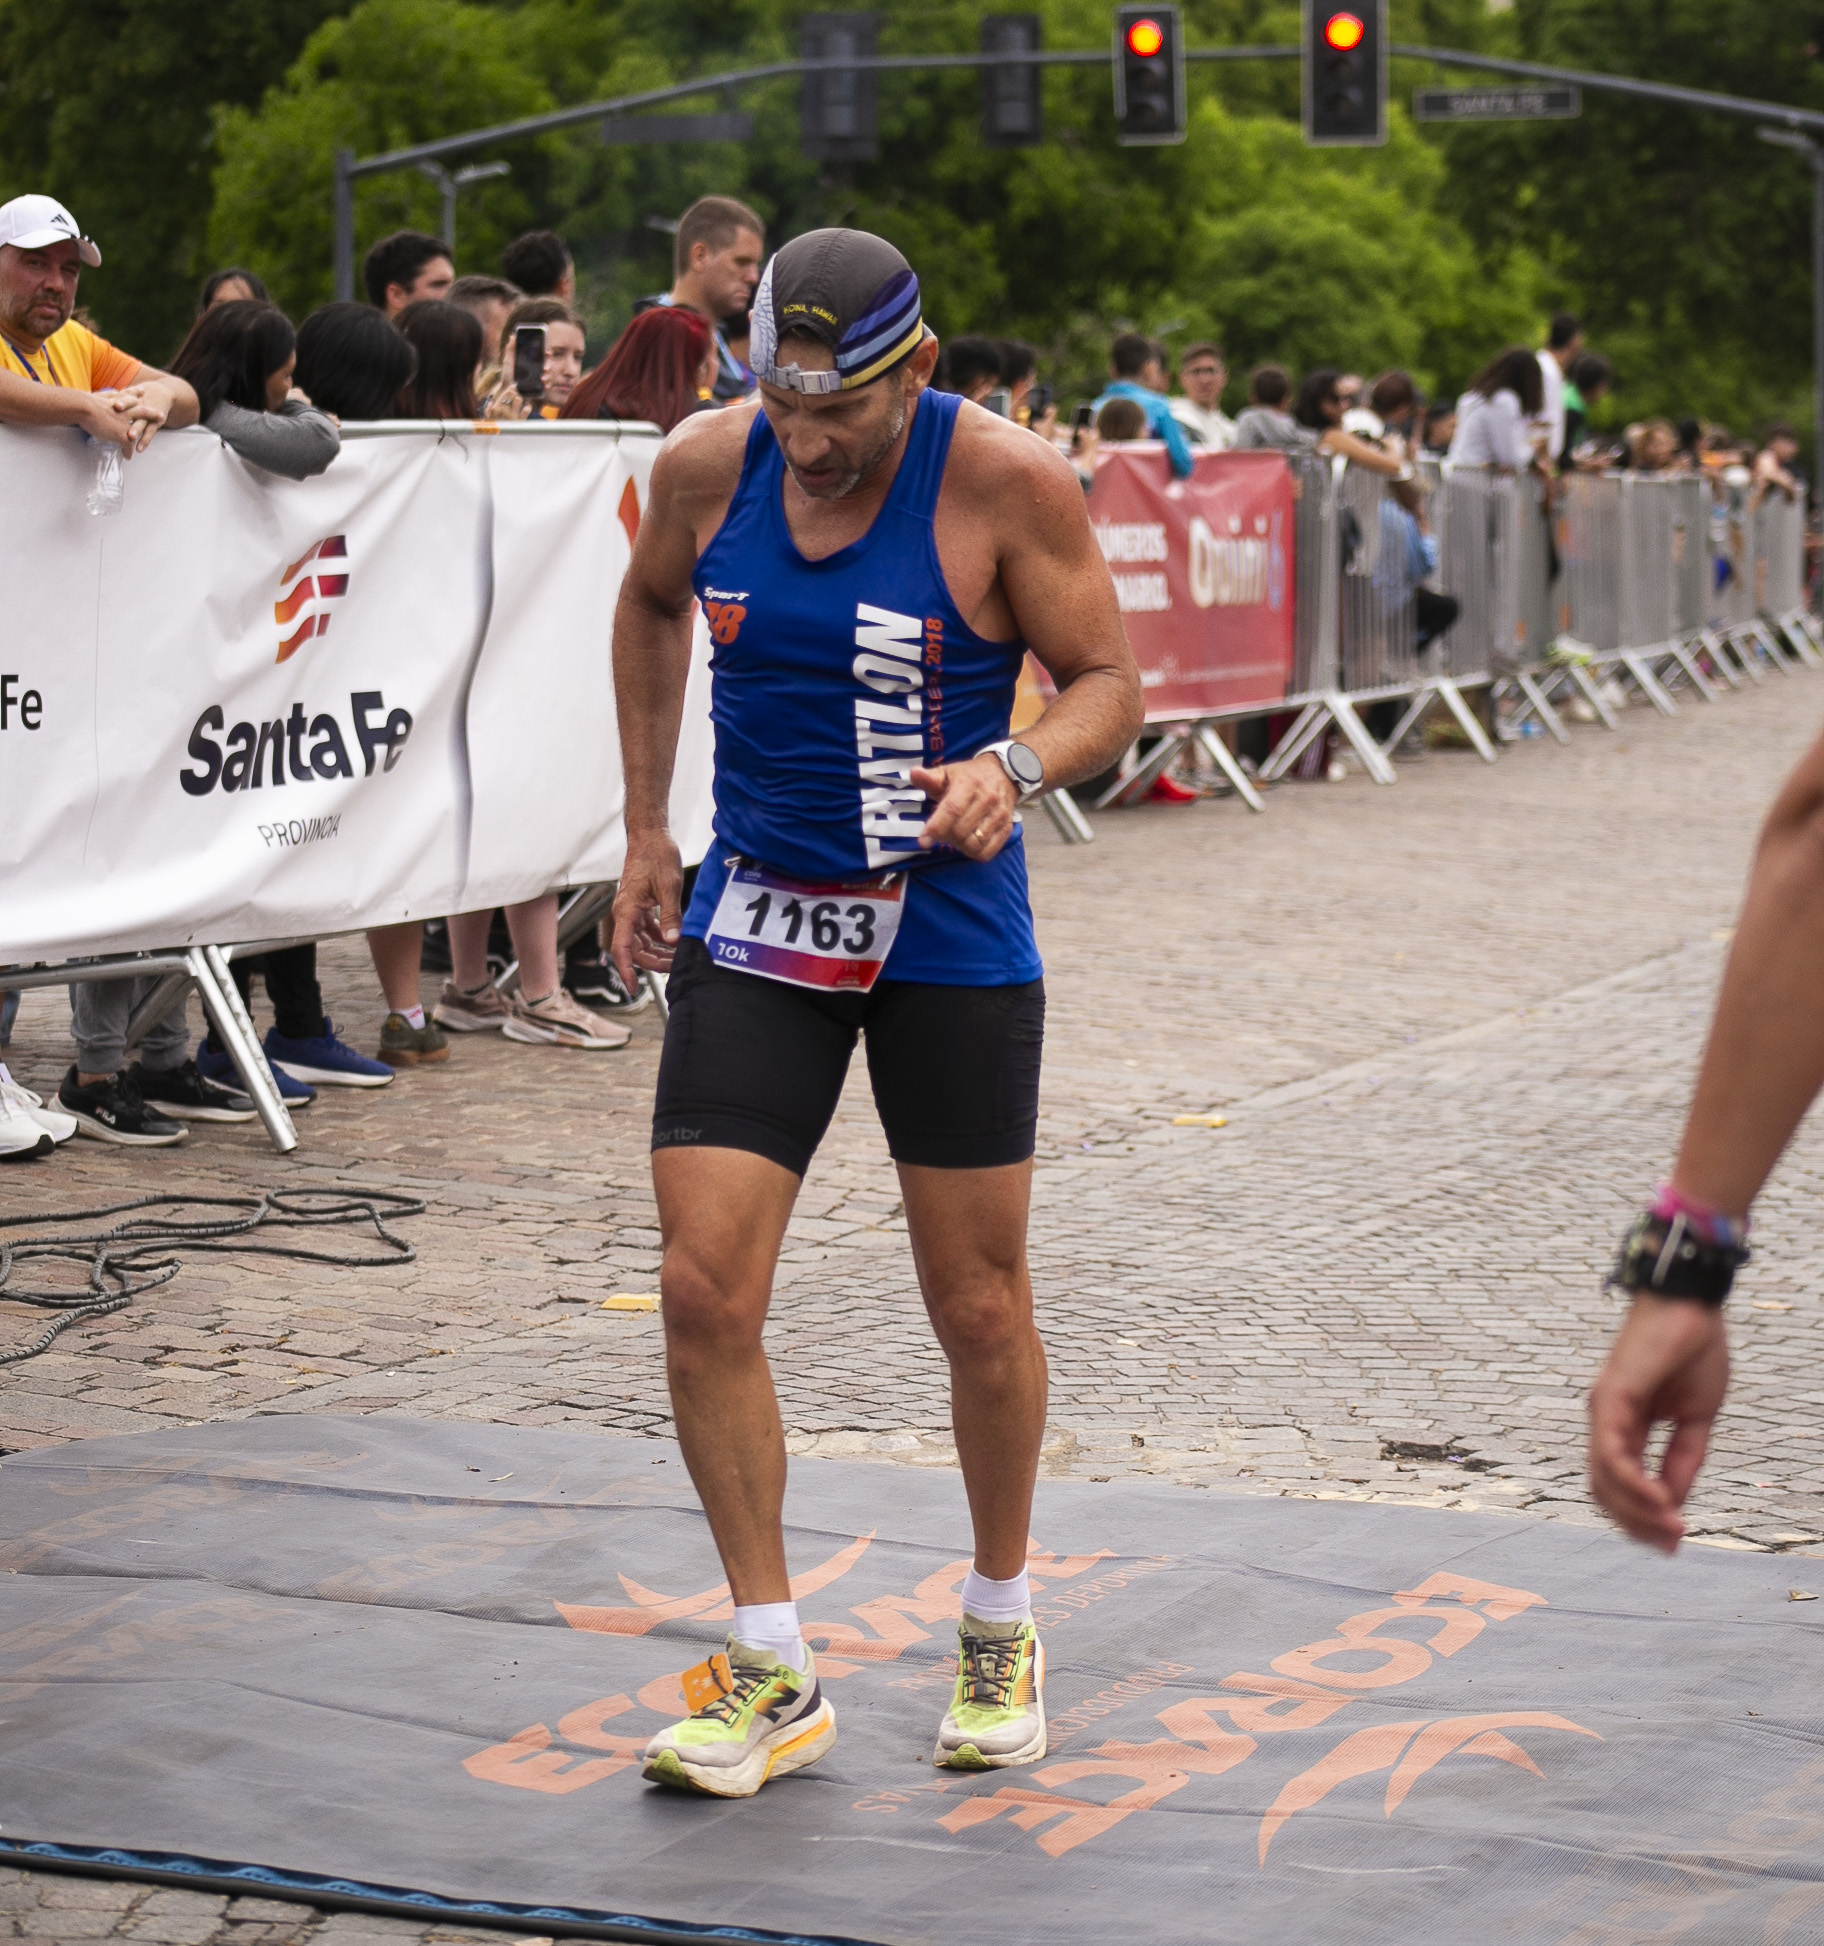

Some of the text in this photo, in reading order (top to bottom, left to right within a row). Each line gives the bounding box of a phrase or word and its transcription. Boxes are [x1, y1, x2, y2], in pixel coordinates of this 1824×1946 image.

[925, 617, 944, 666] 2018
[0, 674, 43, 731] Fe
[180, 690, 412, 797] Santa Fe
[257, 813, 342, 848] PROVINCIA
[745, 891, 876, 955] 1163
